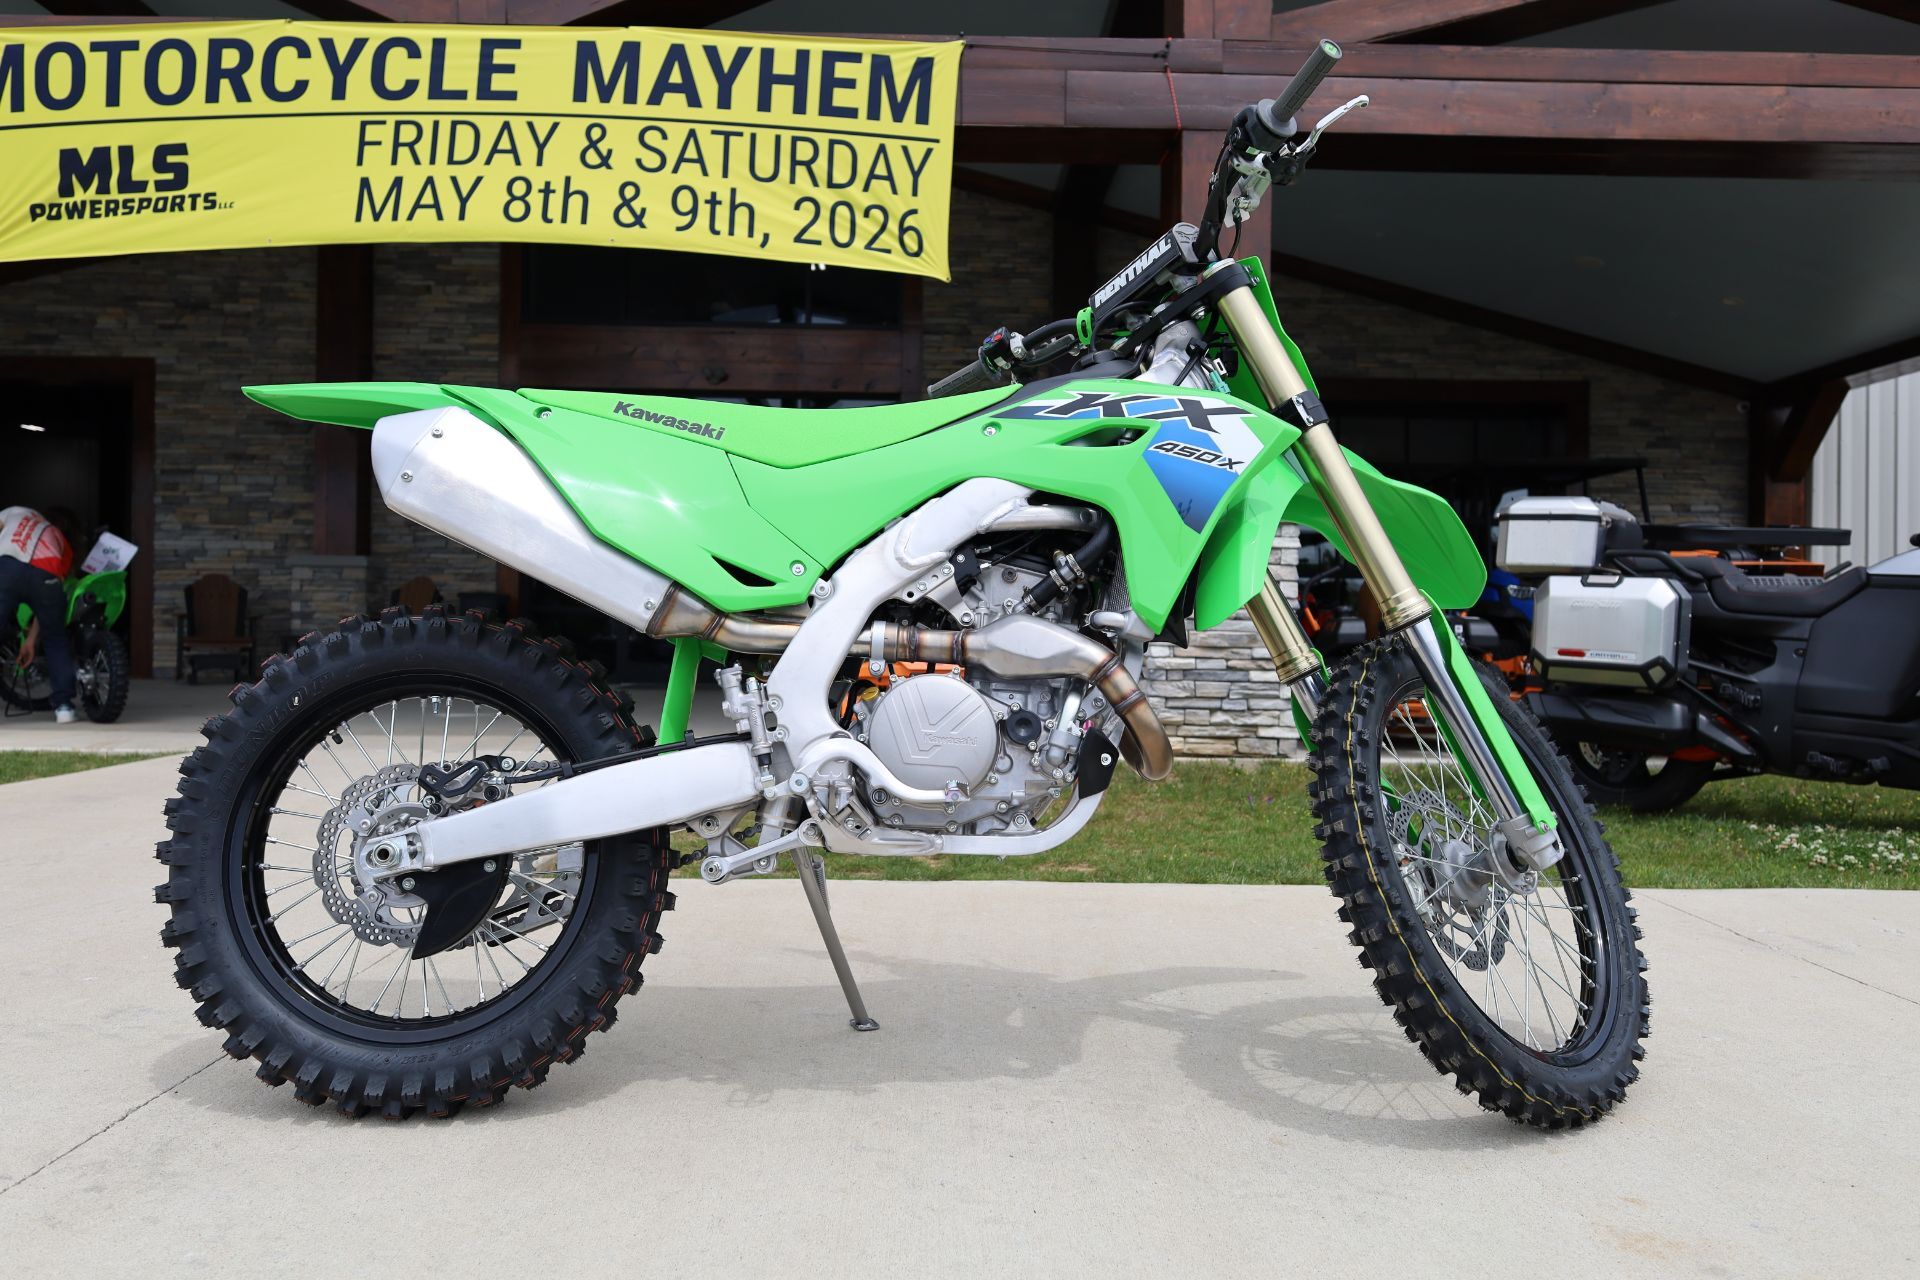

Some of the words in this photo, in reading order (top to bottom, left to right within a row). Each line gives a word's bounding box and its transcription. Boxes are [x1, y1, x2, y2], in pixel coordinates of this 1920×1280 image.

[572, 40, 935, 126] MAYHEM
[57, 142, 189, 199] MLS
[356, 119, 561, 167] FRIDAY
[579, 122, 613, 170] &
[635, 125, 934, 198] SATURDAY
[29, 191, 217, 223] POWERSPORTS
[354, 175, 484, 223] MAY
[502, 175, 589, 225] 8th
[612, 180, 647, 229] &
[671, 184, 770, 249] 9th,
[793, 195, 924, 258] 2026
[1094, 236, 1173, 309] RENTHAL
[613, 400, 726, 441] Kawasaki
[1040, 391, 1257, 435] KX
